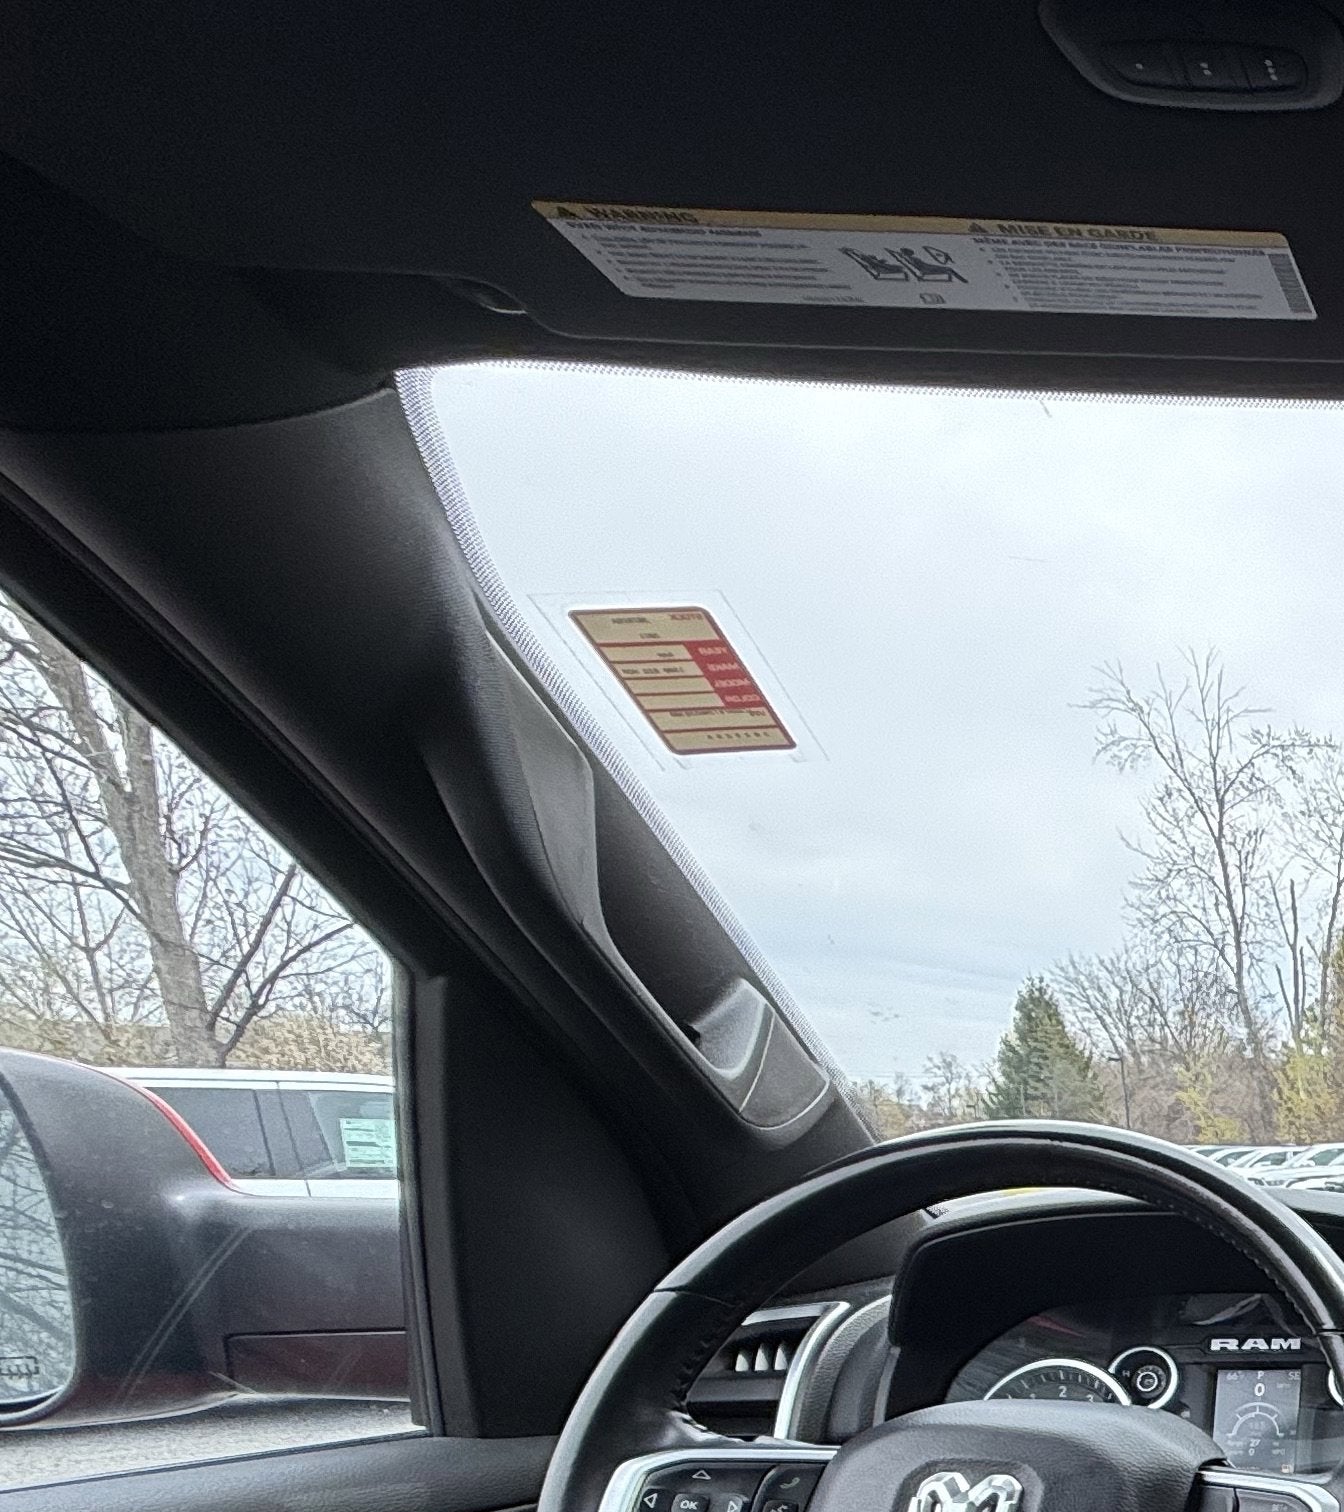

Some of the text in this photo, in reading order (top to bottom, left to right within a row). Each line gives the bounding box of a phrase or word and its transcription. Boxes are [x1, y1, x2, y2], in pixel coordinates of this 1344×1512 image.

[999, 222, 1048, 237] MISE
[1055, 226, 1082, 238] EN
[1210, 1338, 1302, 1351] RAM
[1058, 1385, 1067, 1397] 2
[1254, 1382, 1265, 1397] 0
[680, 1499, 698, 1511] OK
